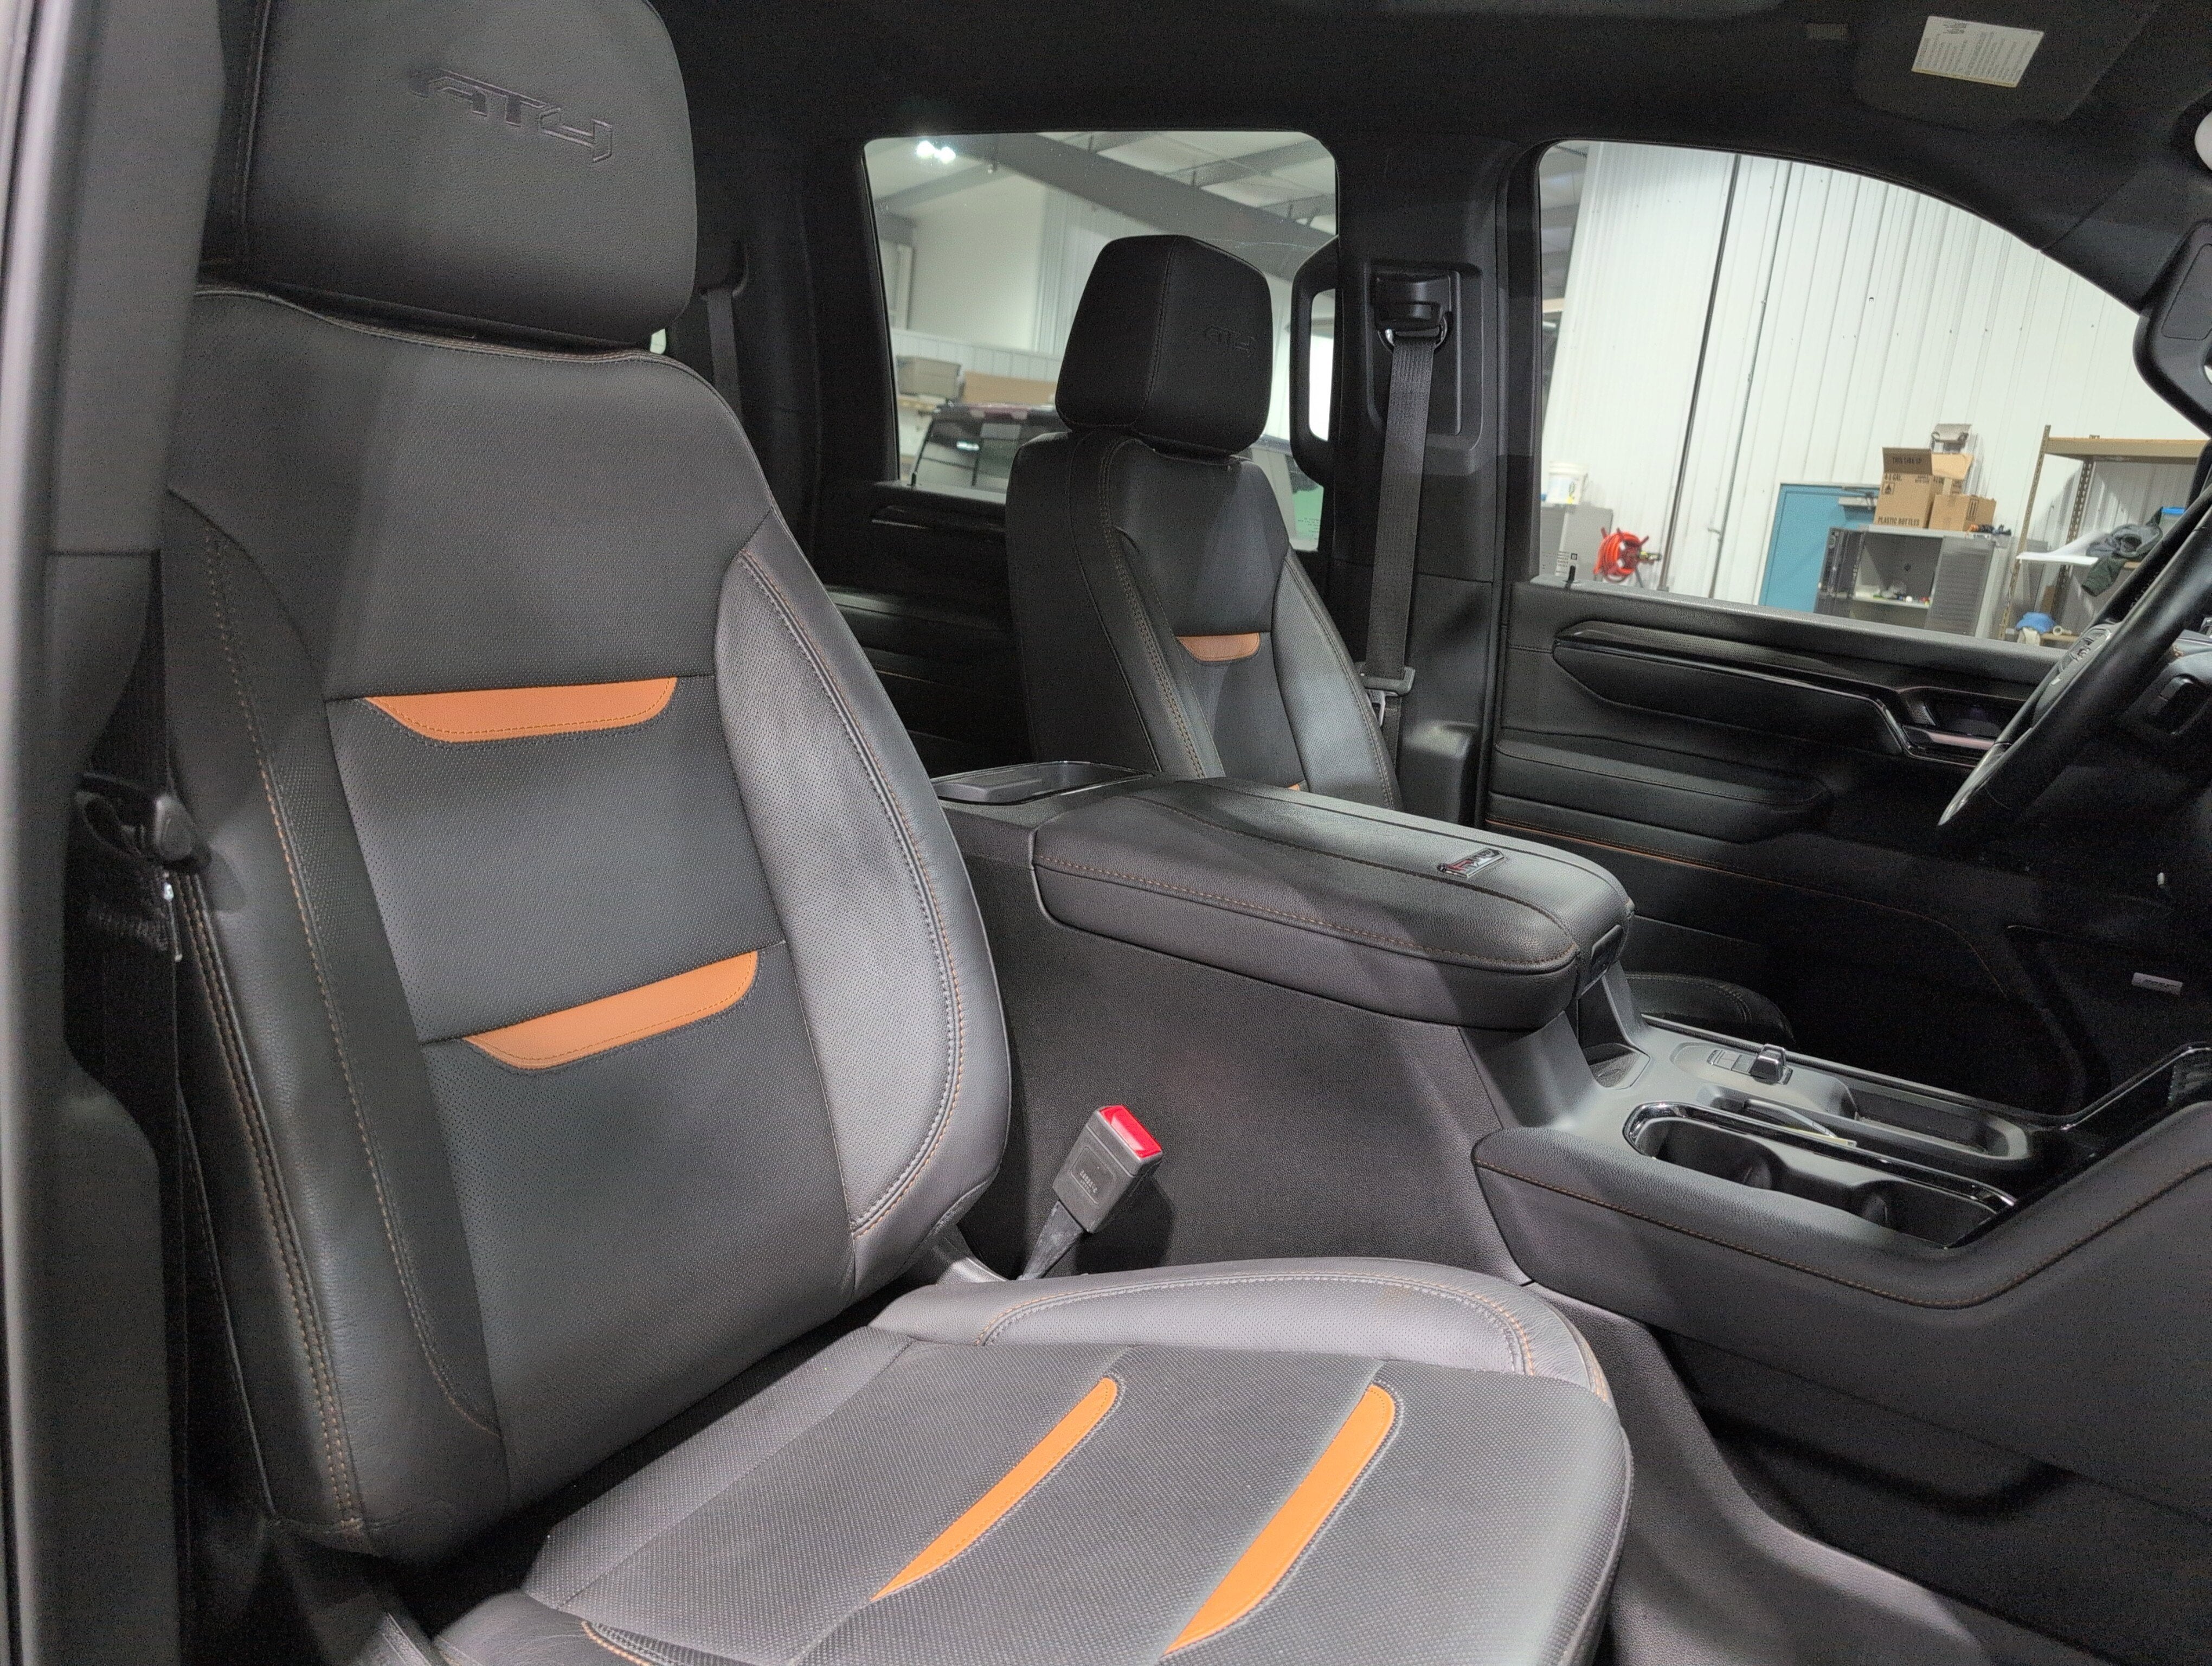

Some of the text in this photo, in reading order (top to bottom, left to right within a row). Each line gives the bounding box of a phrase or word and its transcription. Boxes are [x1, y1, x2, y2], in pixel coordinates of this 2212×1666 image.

[410, 68, 613, 163] AT4
[1877, 515, 1920, 527] PLASTIC BOTTLES
